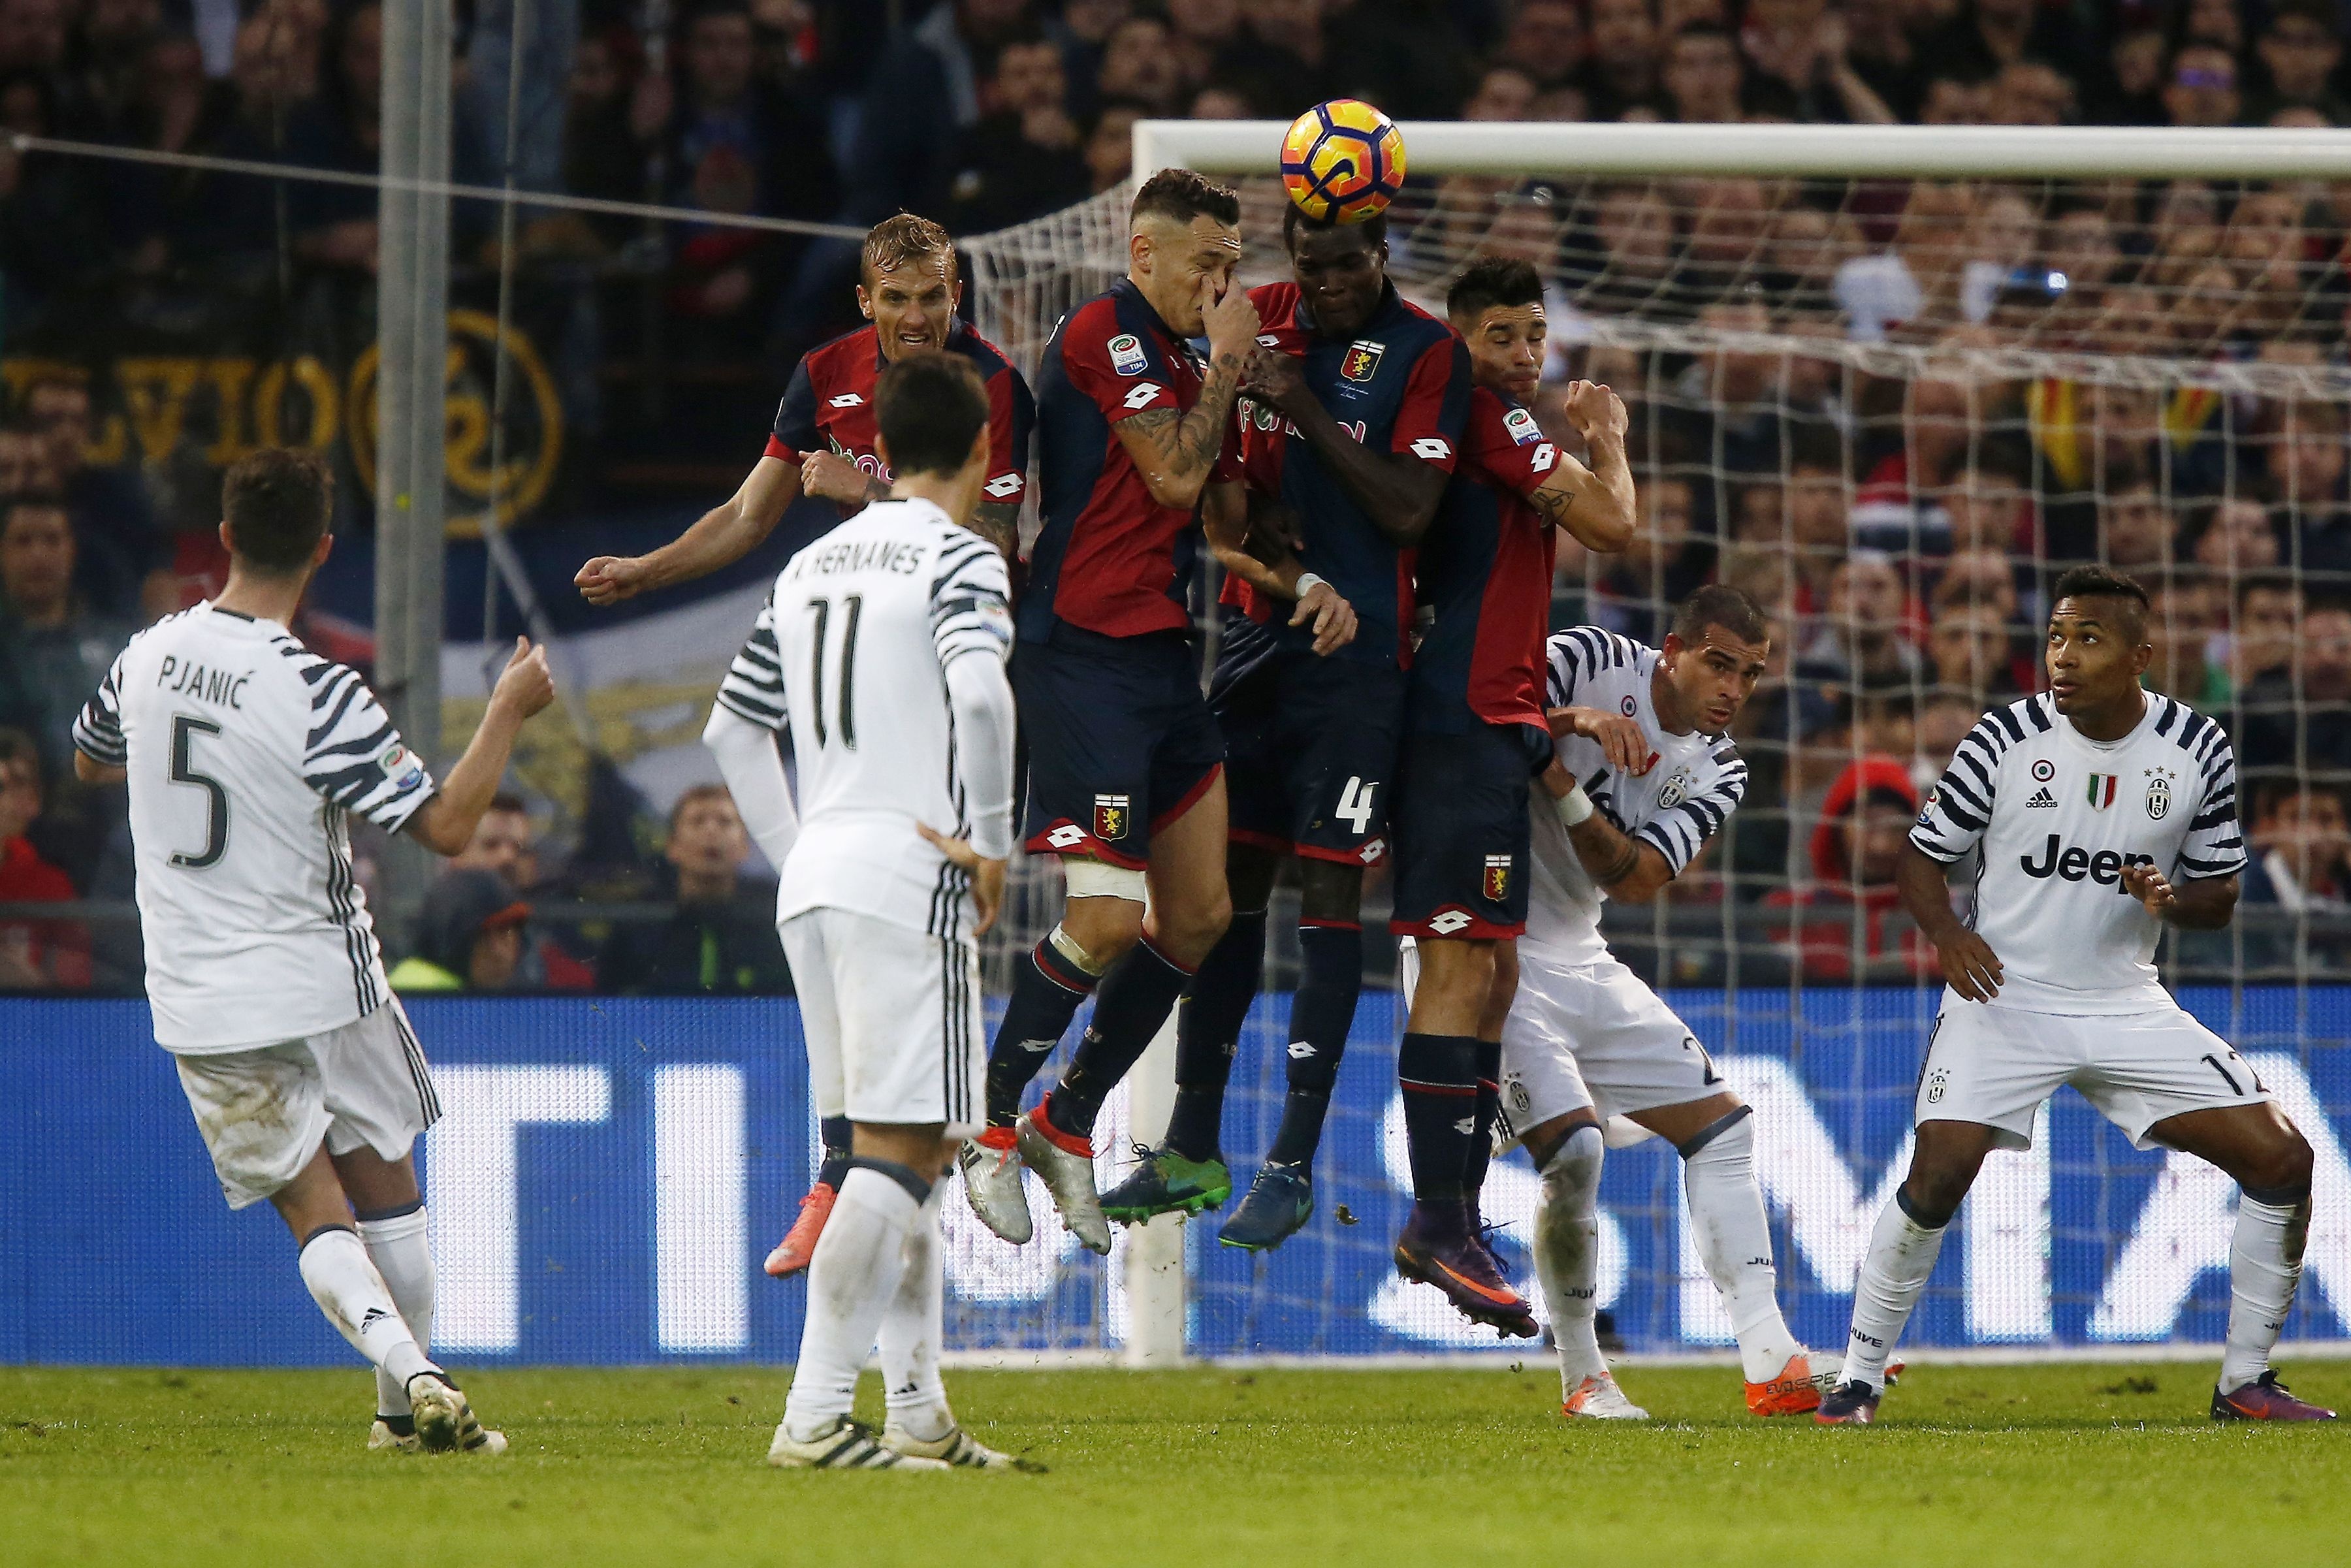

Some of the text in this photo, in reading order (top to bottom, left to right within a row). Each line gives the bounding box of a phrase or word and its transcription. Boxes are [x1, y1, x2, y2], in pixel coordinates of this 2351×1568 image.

[1129, 362, 1143, 370] TIM
[157, 654, 256, 709] PJANIĆ
[806, 592, 863, 752] 11
[167, 711, 230, 870] 5
[1335, 775, 1377, 833] 4
[2026, 800, 2058, 808] adidas
[2021, 834, 2154, 895] Jeep
[2200, 1050, 2271, 1096] 12
[1849, 1327, 1883, 1348] JUVE
